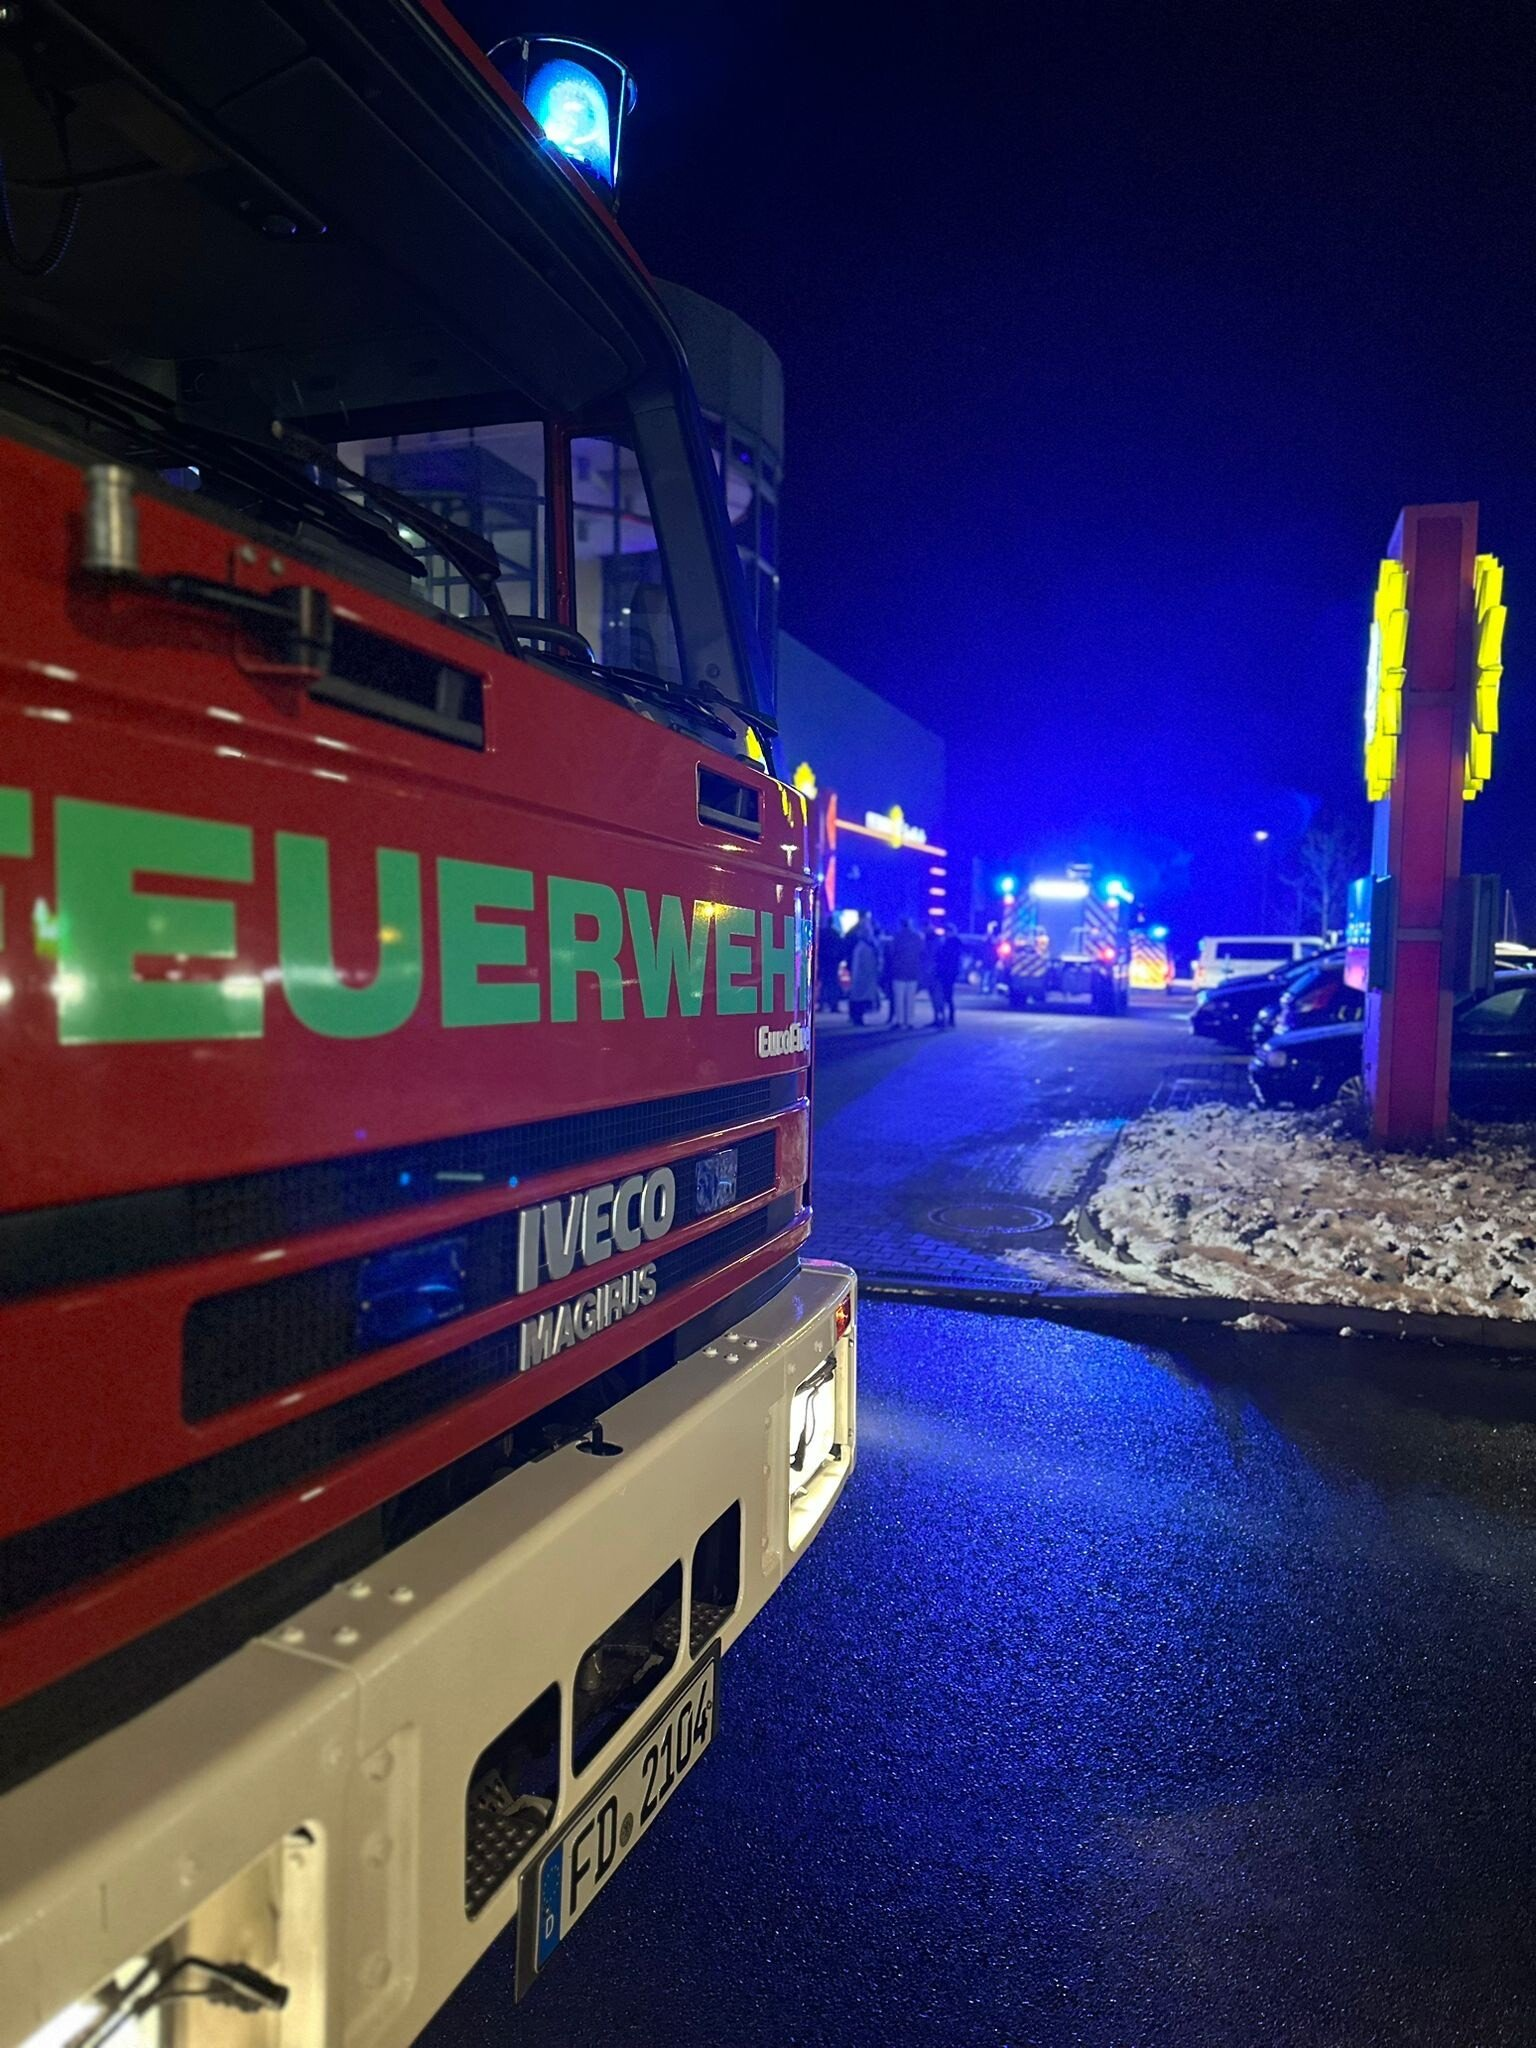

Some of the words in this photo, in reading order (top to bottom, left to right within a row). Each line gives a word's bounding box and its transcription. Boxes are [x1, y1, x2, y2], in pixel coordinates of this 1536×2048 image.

[0, 785, 813, 1045] EUERWEH
[517, 1167, 675, 1294] IVECO
[520, 1262, 657, 1371] MAGIRUS
[569, 1795, 618, 1917] FD
[640, 1680, 709, 1828] 2104
[545, 1912, 555, 1939] D
